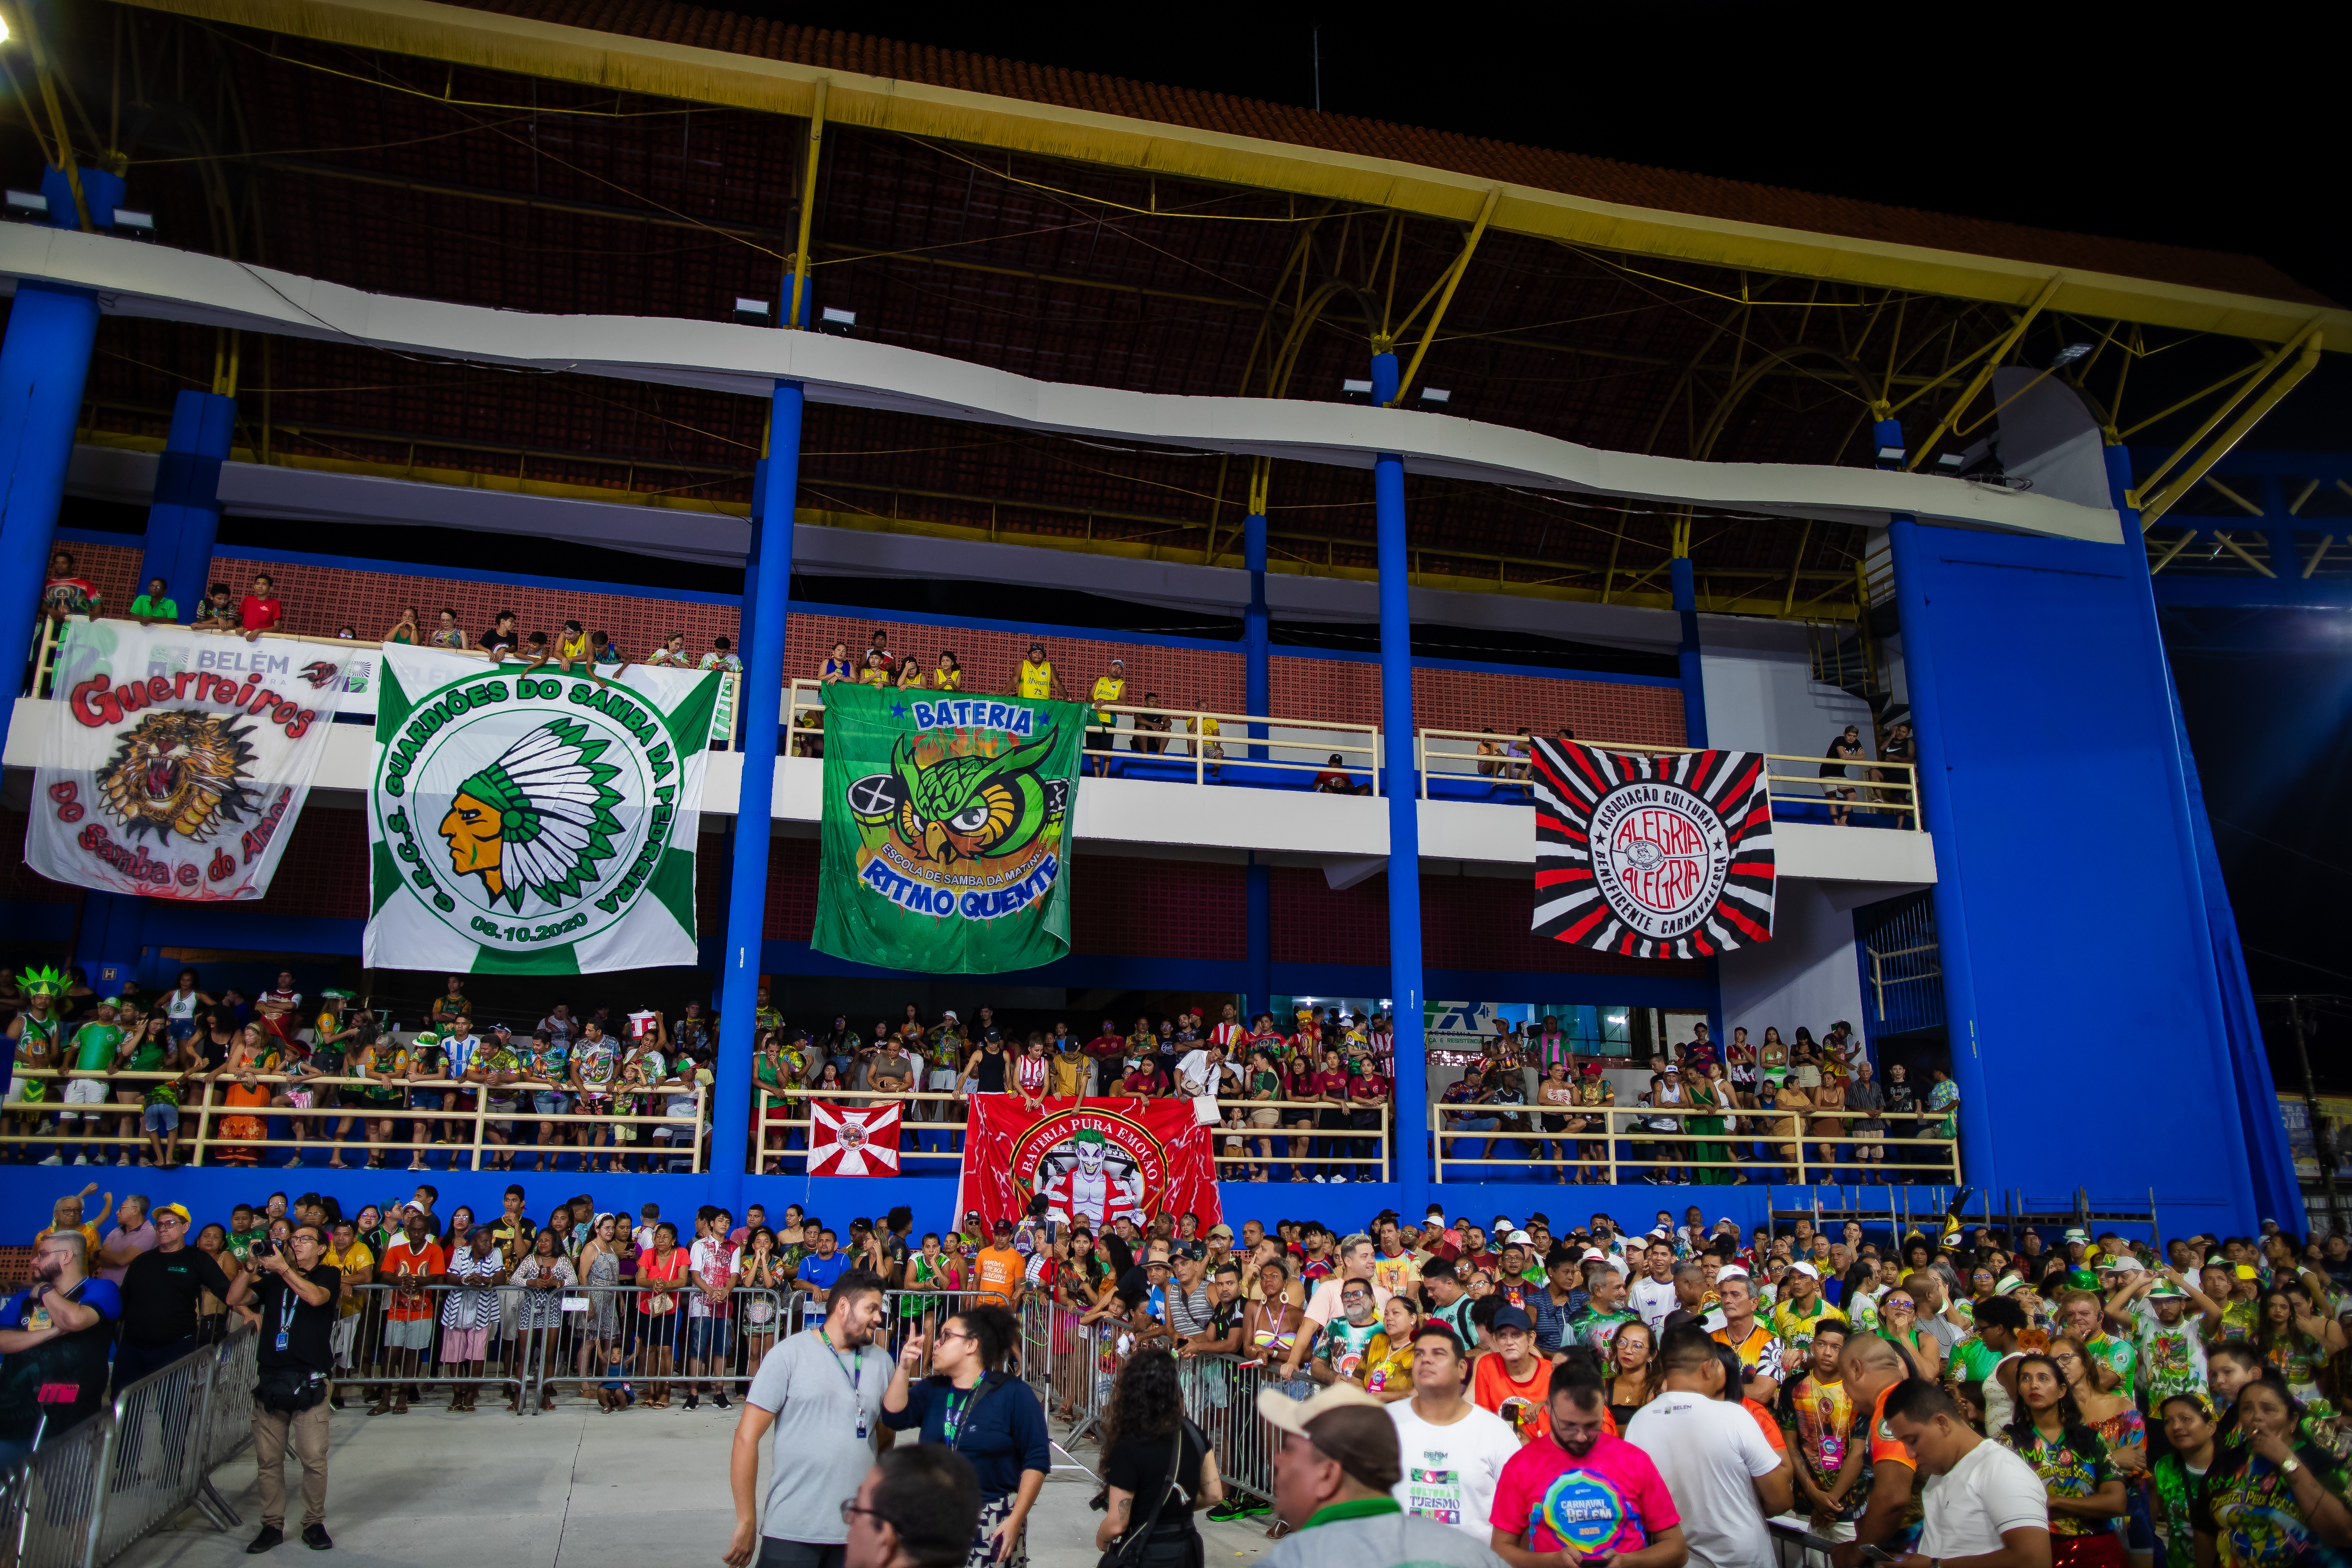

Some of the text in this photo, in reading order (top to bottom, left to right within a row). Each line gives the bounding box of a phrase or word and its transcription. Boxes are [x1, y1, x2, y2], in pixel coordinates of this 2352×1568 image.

[198, 650, 290, 674] BELÉM
[70, 671, 315, 738] Guerreiros
[517, 679, 562, 699] DO
[569, 684, 658, 747] SAMBA
[912, 699, 1033, 735] BATERIA
[386, 680, 509, 798] GUARDIÕES
[646, 741, 674, 784] DA
[1598, 786, 1718, 834] ASSOCIAÇÃO CULTURAL
[594, 784, 676, 914] PEDREIRA
[1617, 811, 1703, 854] ALEGRIA
[178, 863, 199, 886] e
[207, 846, 236, 882] do
[859, 851, 1058, 921] RITMO QUENTE
[881, 843, 923, 877] ESCOLA
[925, 870, 941, 883] DE
[944, 874, 985, 886] SAMBA
[987, 874, 1004, 886] DA
[1622, 859, 1700, 909] ALEGRIA
[1594, 850, 1727, 934] BENEFICENTE CARNAVALESCA
[470, 912, 588, 943] 08.10.2020
[105, 970, 115, 979] H
[1447, 1036, 1482, 1044] RESISTÊNCIA
[1022, 1118, 1158, 1180] BATERIA PURA EMOÇÃO
[1409, 1496, 1460, 1510] TURISMO
[1561, 1499, 1607, 1509] CARNAVAL
